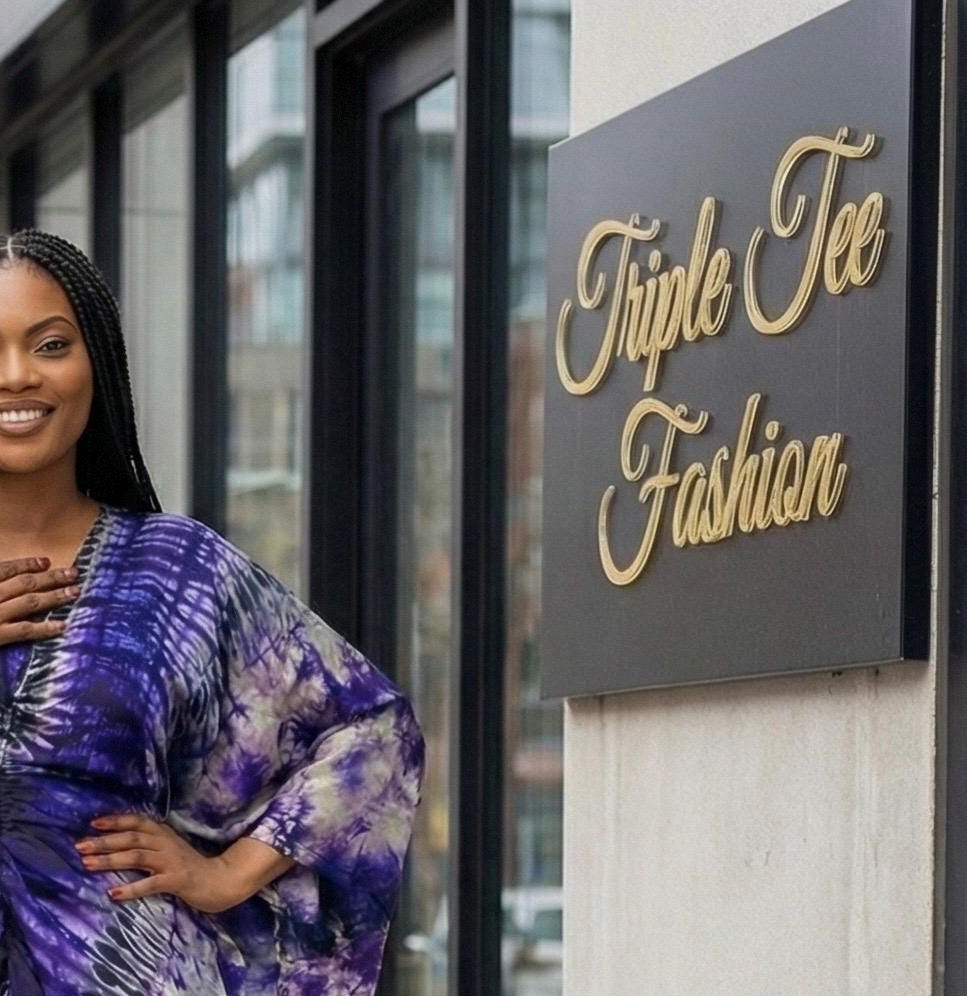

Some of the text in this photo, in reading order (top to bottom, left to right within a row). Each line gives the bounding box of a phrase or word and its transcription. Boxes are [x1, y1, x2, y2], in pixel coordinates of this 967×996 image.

[556, 127, 886, 394] Triple Tee
[598, 393, 847, 586] Fashion
